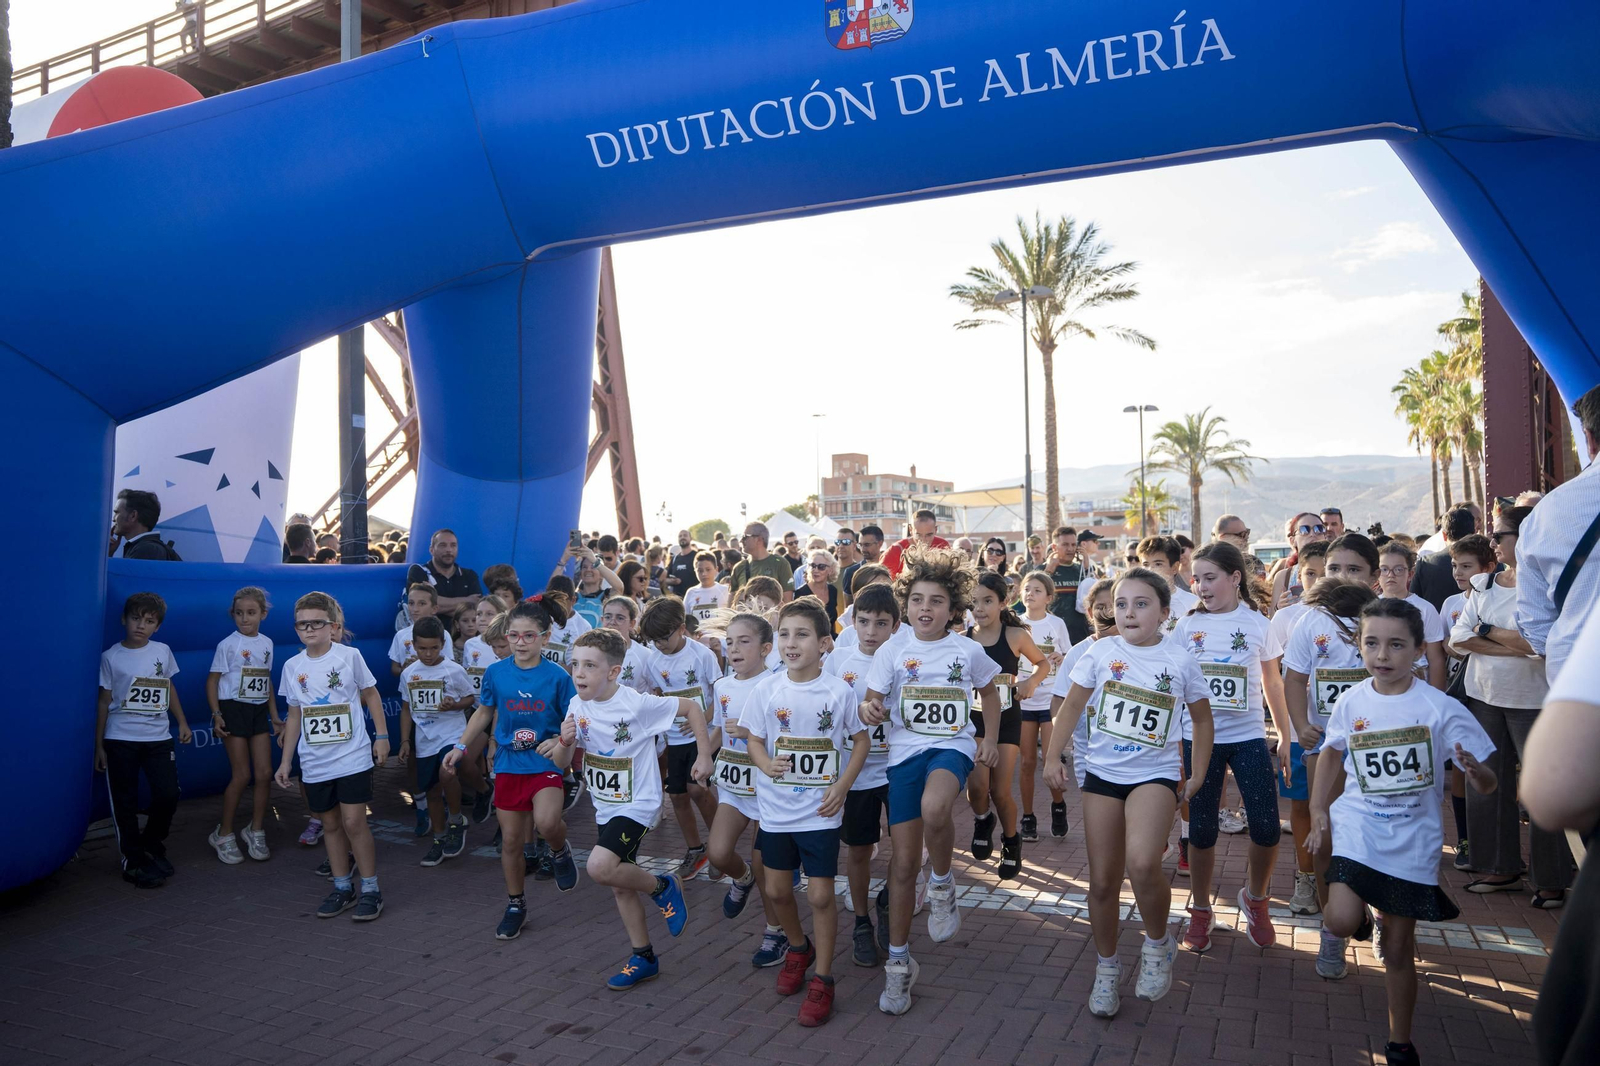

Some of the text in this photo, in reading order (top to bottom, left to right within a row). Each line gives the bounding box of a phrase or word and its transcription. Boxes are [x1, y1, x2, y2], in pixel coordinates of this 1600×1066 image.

[586, 9, 1236, 168] DIPUTACIÓN DE ALMERÍA
[247, 678, 268, 691] 431
[129, 688, 161, 703] 295
[418, 690, 436, 704] 511
[506, 700, 546, 712] GALO
[913, 702, 957, 724] 280
[1113, 700, 1160, 732] 115
[310, 716, 341, 735] 231
[788, 753, 828, 774] 107
[1365, 748, 1421, 778] 564
[587, 768, 620, 792] 104
[720, 764, 751, 786] 401
